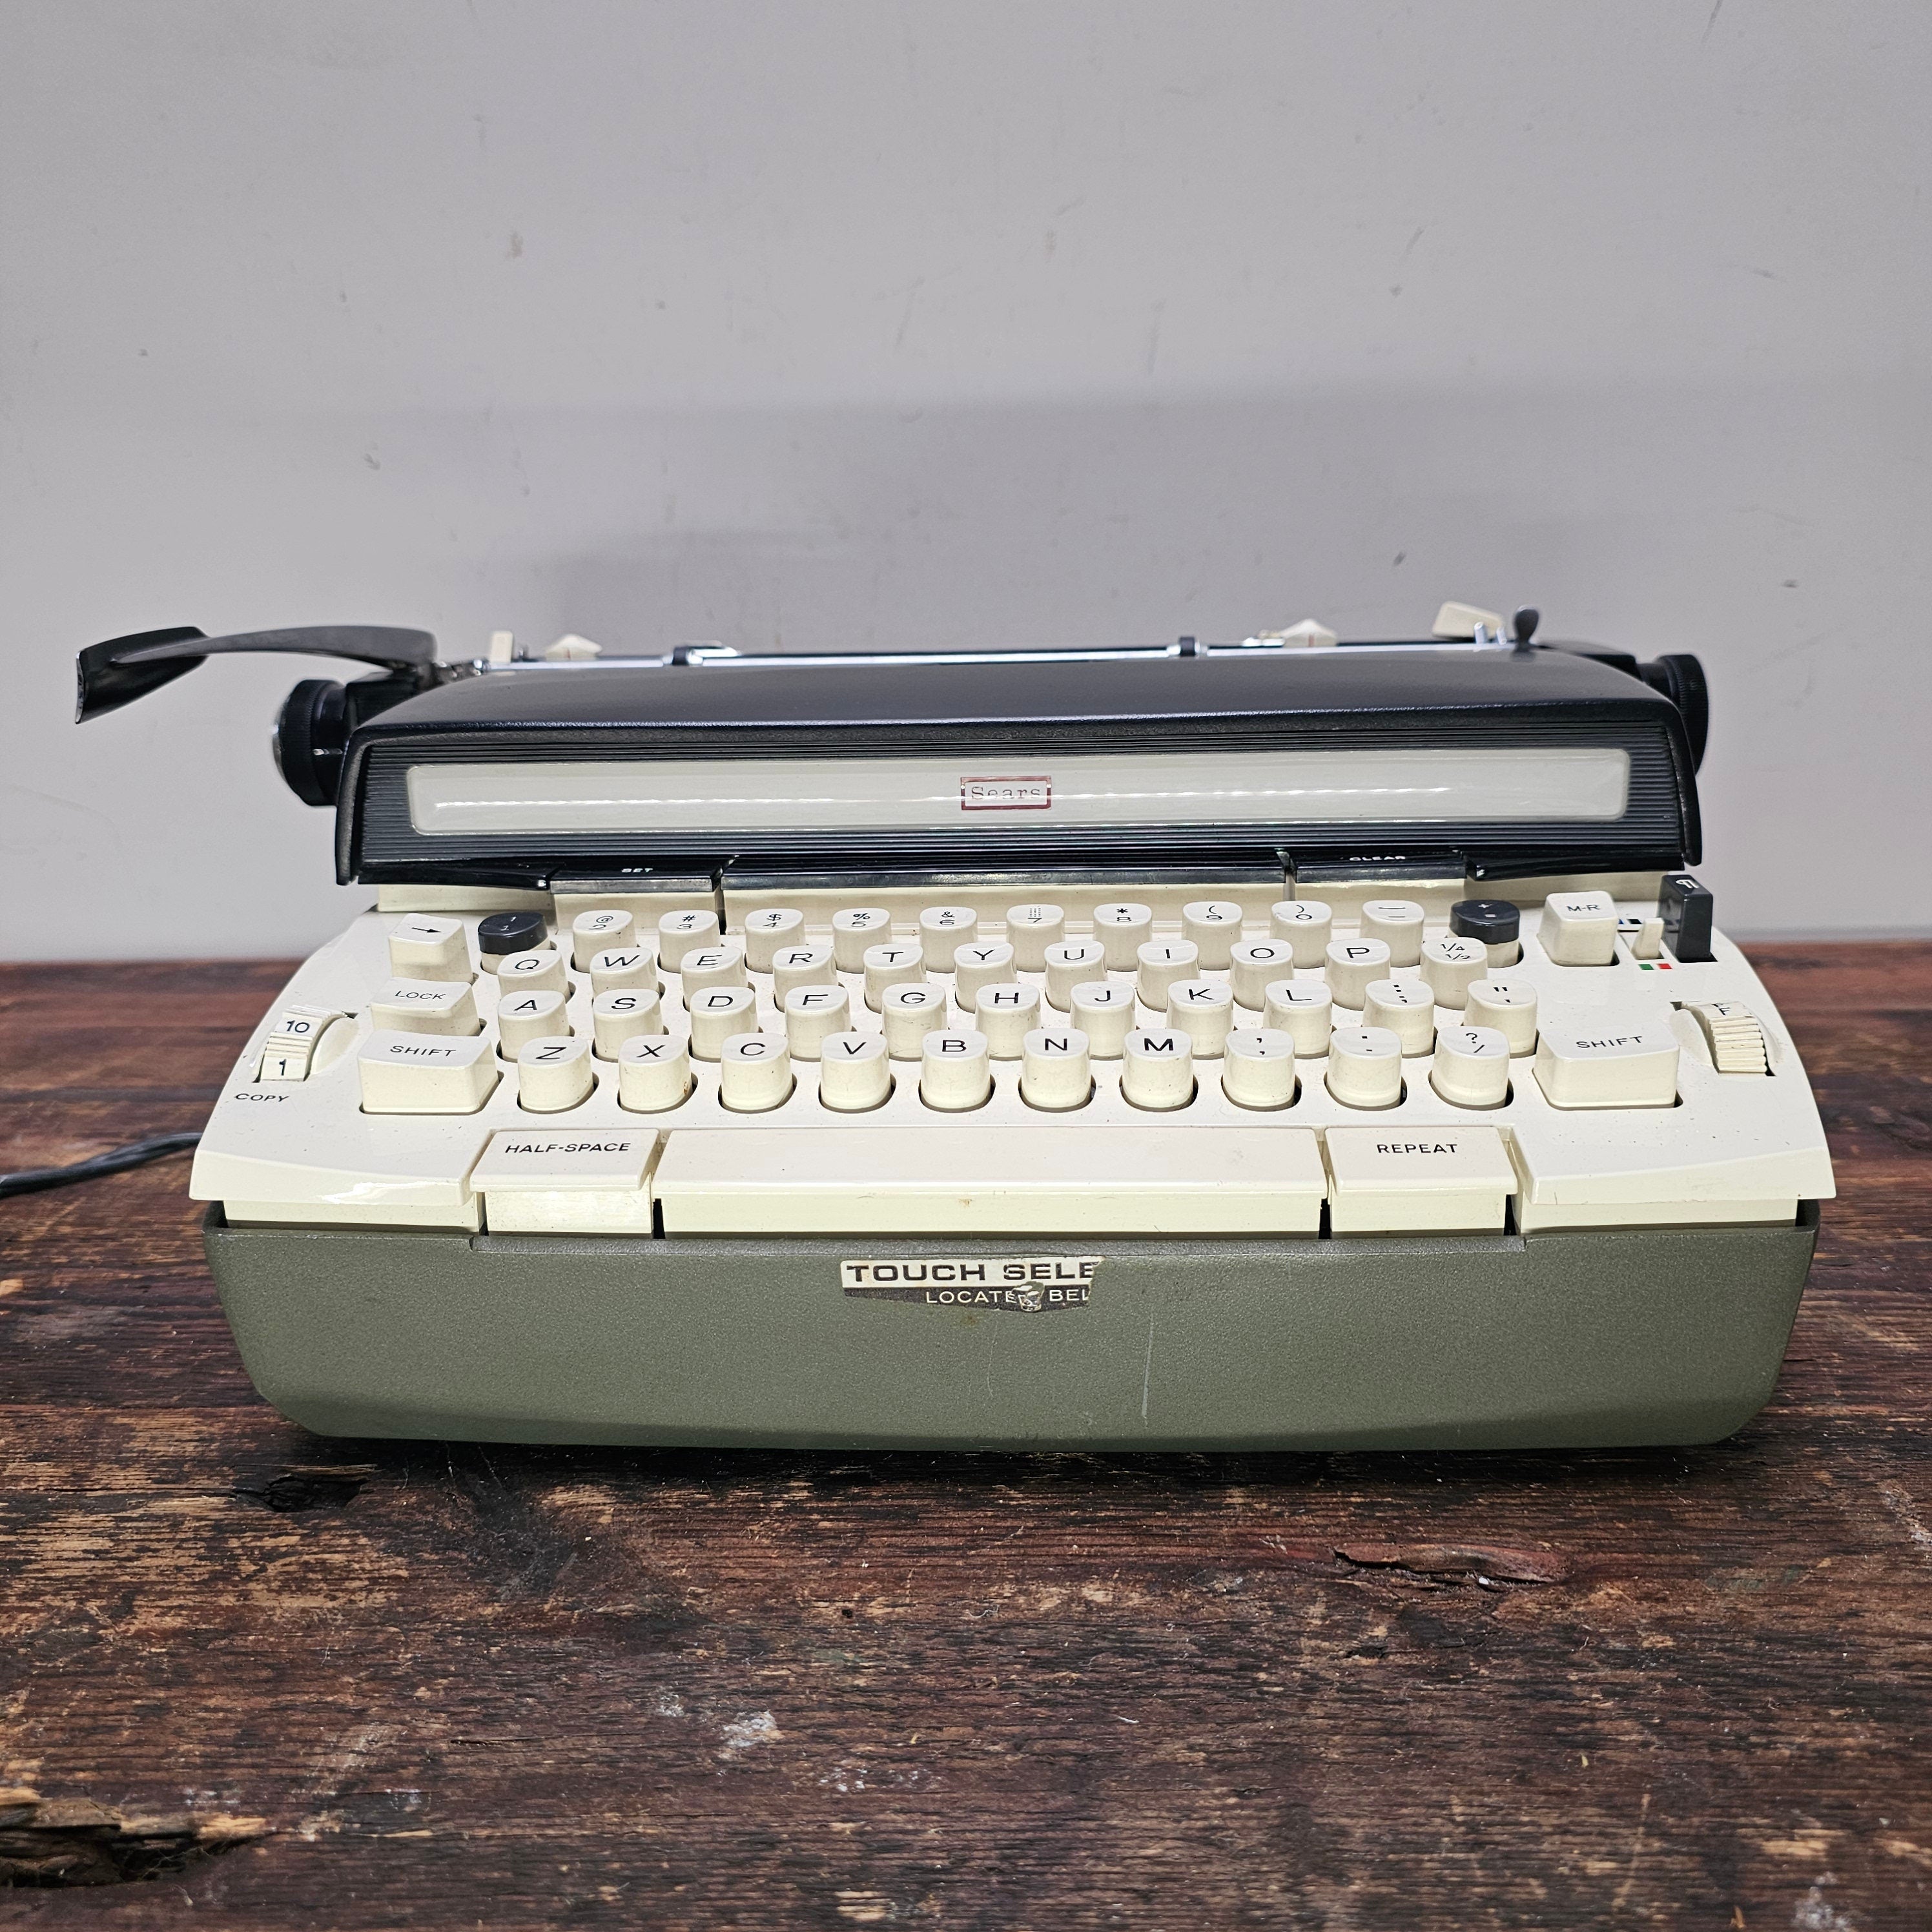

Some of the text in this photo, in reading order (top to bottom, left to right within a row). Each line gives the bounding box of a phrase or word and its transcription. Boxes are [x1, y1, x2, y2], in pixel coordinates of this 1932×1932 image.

[969, 784, 1043, 802] Sears
[595, 915, 613, 923] @
[766, 913, 782, 921] $
[852, 912, 870, 921] %
[788, 952, 814, 964] R
[882, 951, 904, 963] T
[972, 949, 995, 961] Y
[1064, 949, 1085, 960] U
[1249, 947, 1275, 959] O
[1346, 947, 1370, 959] P
[515, 959, 540, 971] Q
[604, 954, 640, 967] W
[696, 954, 723, 966] E
[395, 991, 447, 1000] LOCK
[802, 994, 828, 1006] F
[900, 992, 926, 1004] G
[994, 992, 1020, 1004] H
[1094, 990, 1111, 1002] J
[1188, 989, 1215, 1000] K
[1286, 989, 1312, 1002] L
[513, 1000, 538, 1011] A
[611, 998, 637, 1010] S
[707, 996, 734, 1007] D
[286, 1020, 311, 1033] 10
[1045, 1038, 1068, 1051] N
[1465, 1033, 1478, 1044] ?
[1576, 1036, 1642, 1049] SHIFT
[390, 1045, 456, 1056] SHIFT
[740, 1042, 766, 1056] C
[843, 1042, 867, 1055] V
[941, 1040, 967, 1053] B
[1144, 1038, 1174, 1052] M
[535, 1047, 567, 1060] Z
[637, 1045, 665, 1058] X
[279, 1059, 287, 1076] 1
[235, 1093, 289, 1102] COPY
[505, 1143, 631, 1153] HALF-SPACE
[1376, 1144, 1457, 1153] REPEAT
[846, 1263, 986, 1282] TOUCH
